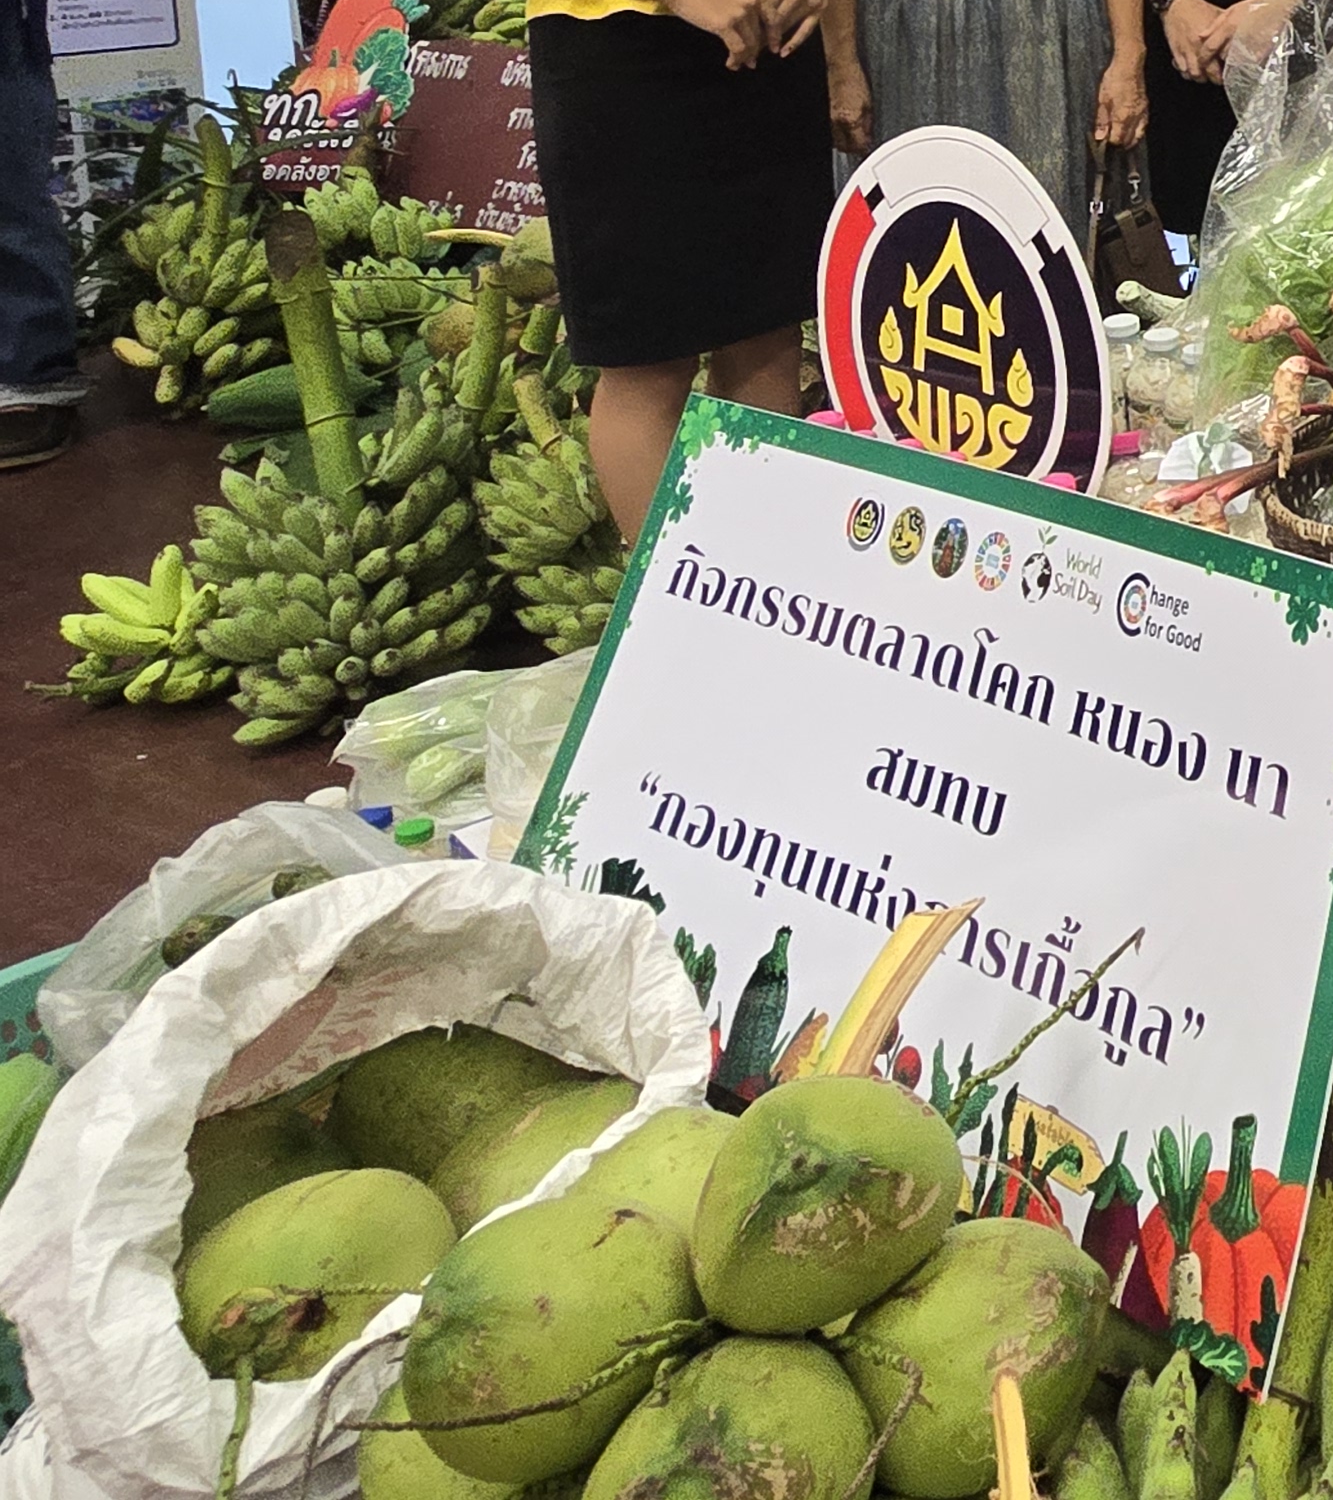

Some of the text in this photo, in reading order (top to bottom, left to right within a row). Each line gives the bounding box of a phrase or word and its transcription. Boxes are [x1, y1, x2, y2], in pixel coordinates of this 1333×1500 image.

[1065, 548, 1103, 580] World
[1053, 573, 1103, 614] Soil Day
[1144, 615, 1203, 652] for Good
[665, 544, 1291, 820] กิจกรรมตลาดโคก หนอง นา
[866, 746, 1008, 836] สมทบ
